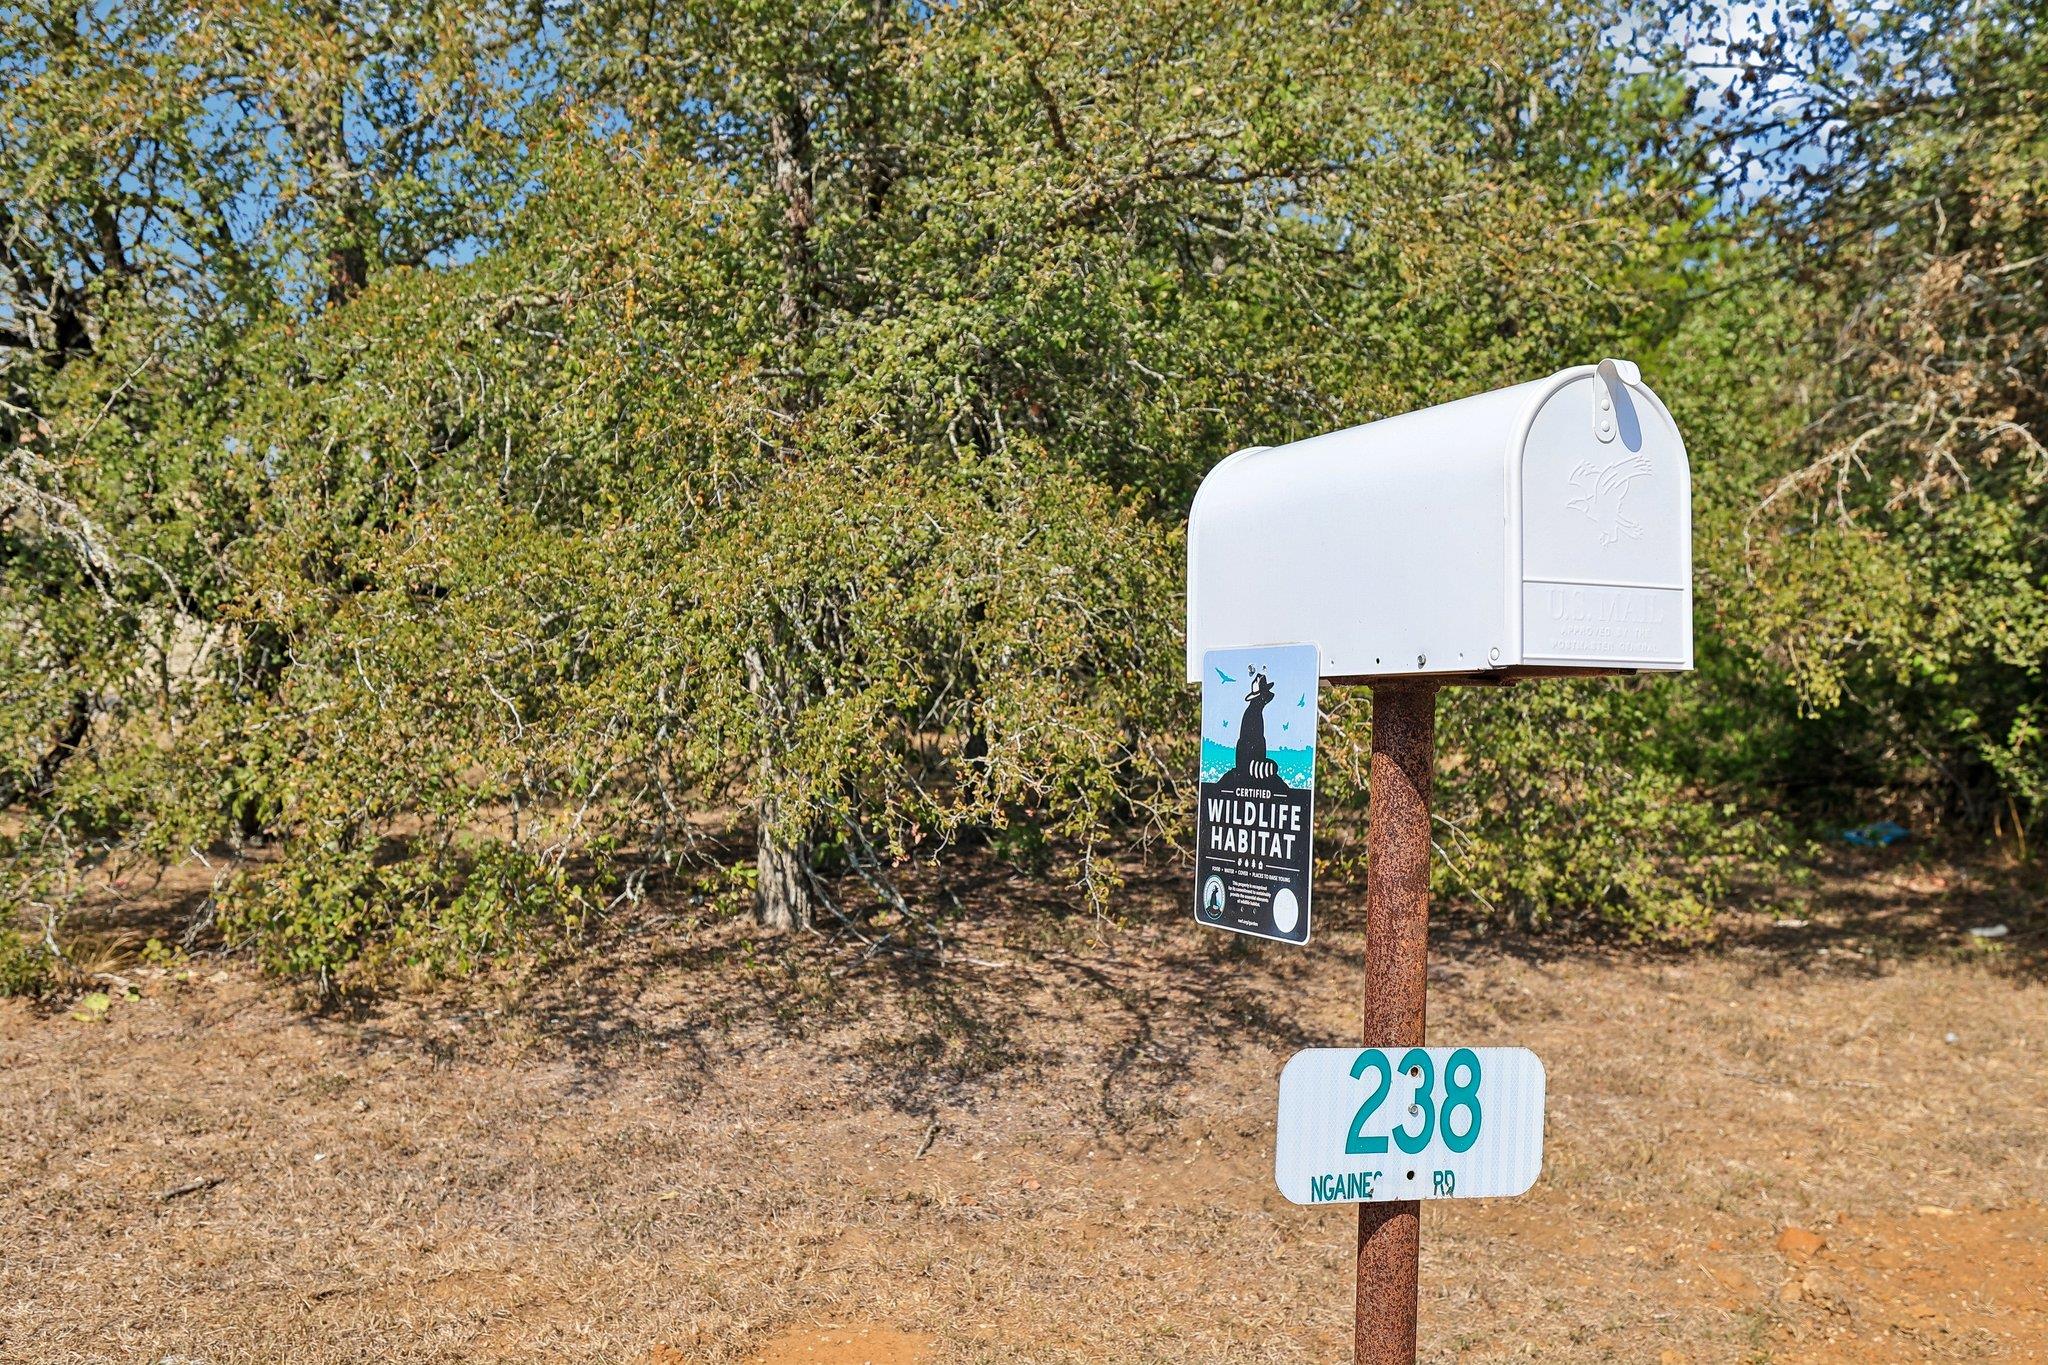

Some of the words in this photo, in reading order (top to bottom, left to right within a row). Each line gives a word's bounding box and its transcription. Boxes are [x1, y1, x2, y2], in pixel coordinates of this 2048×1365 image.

[1235, 787, 1272, 799] CERTIFIED
[1208, 798, 1301, 831] WILDLIFE
[1211, 825, 1296, 860] HABITAT
[1345, 1048, 1482, 1154] 238
[1433, 1170, 1455, 1197] RD
